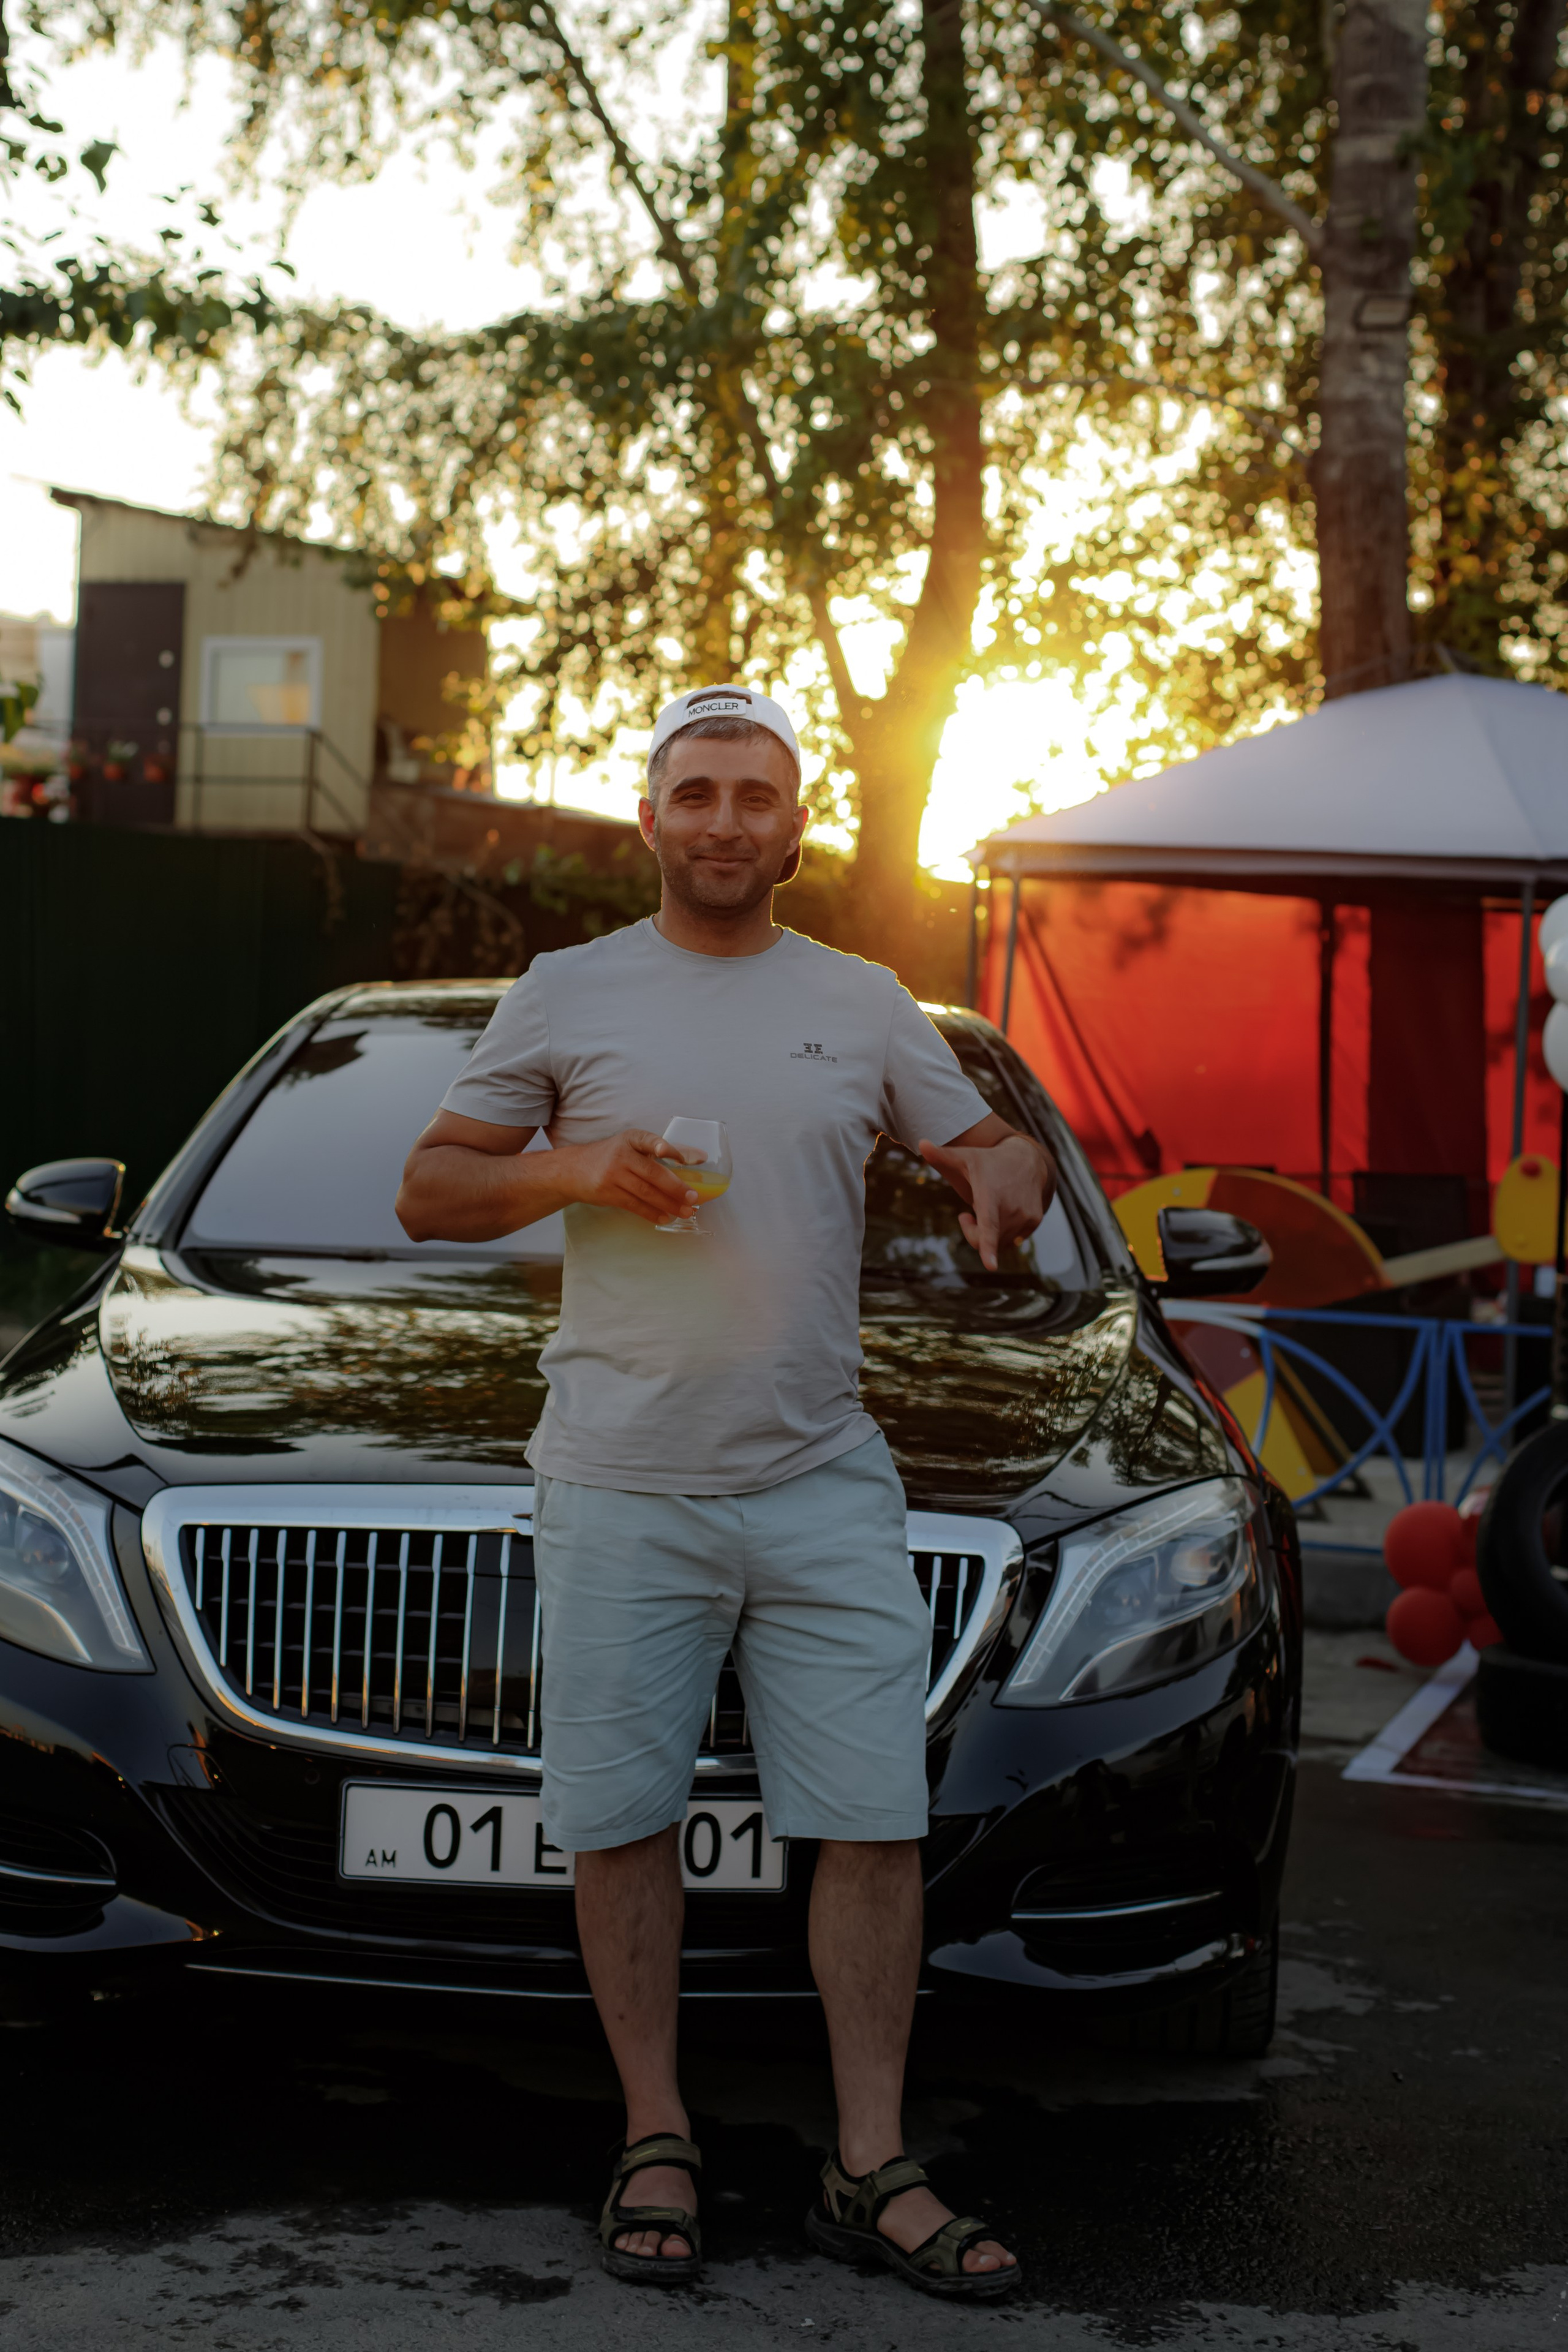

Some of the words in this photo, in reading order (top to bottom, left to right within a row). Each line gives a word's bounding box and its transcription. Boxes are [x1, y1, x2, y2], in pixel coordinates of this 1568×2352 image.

[688, 702, 739, 717] MONCLER
[790, 1052, 838, 1063] DELICATE
[423, 1803, 503, 1872] 01
[684, 1812, 763, 1879] 01
[365, 1849, 398, 1868] AM
